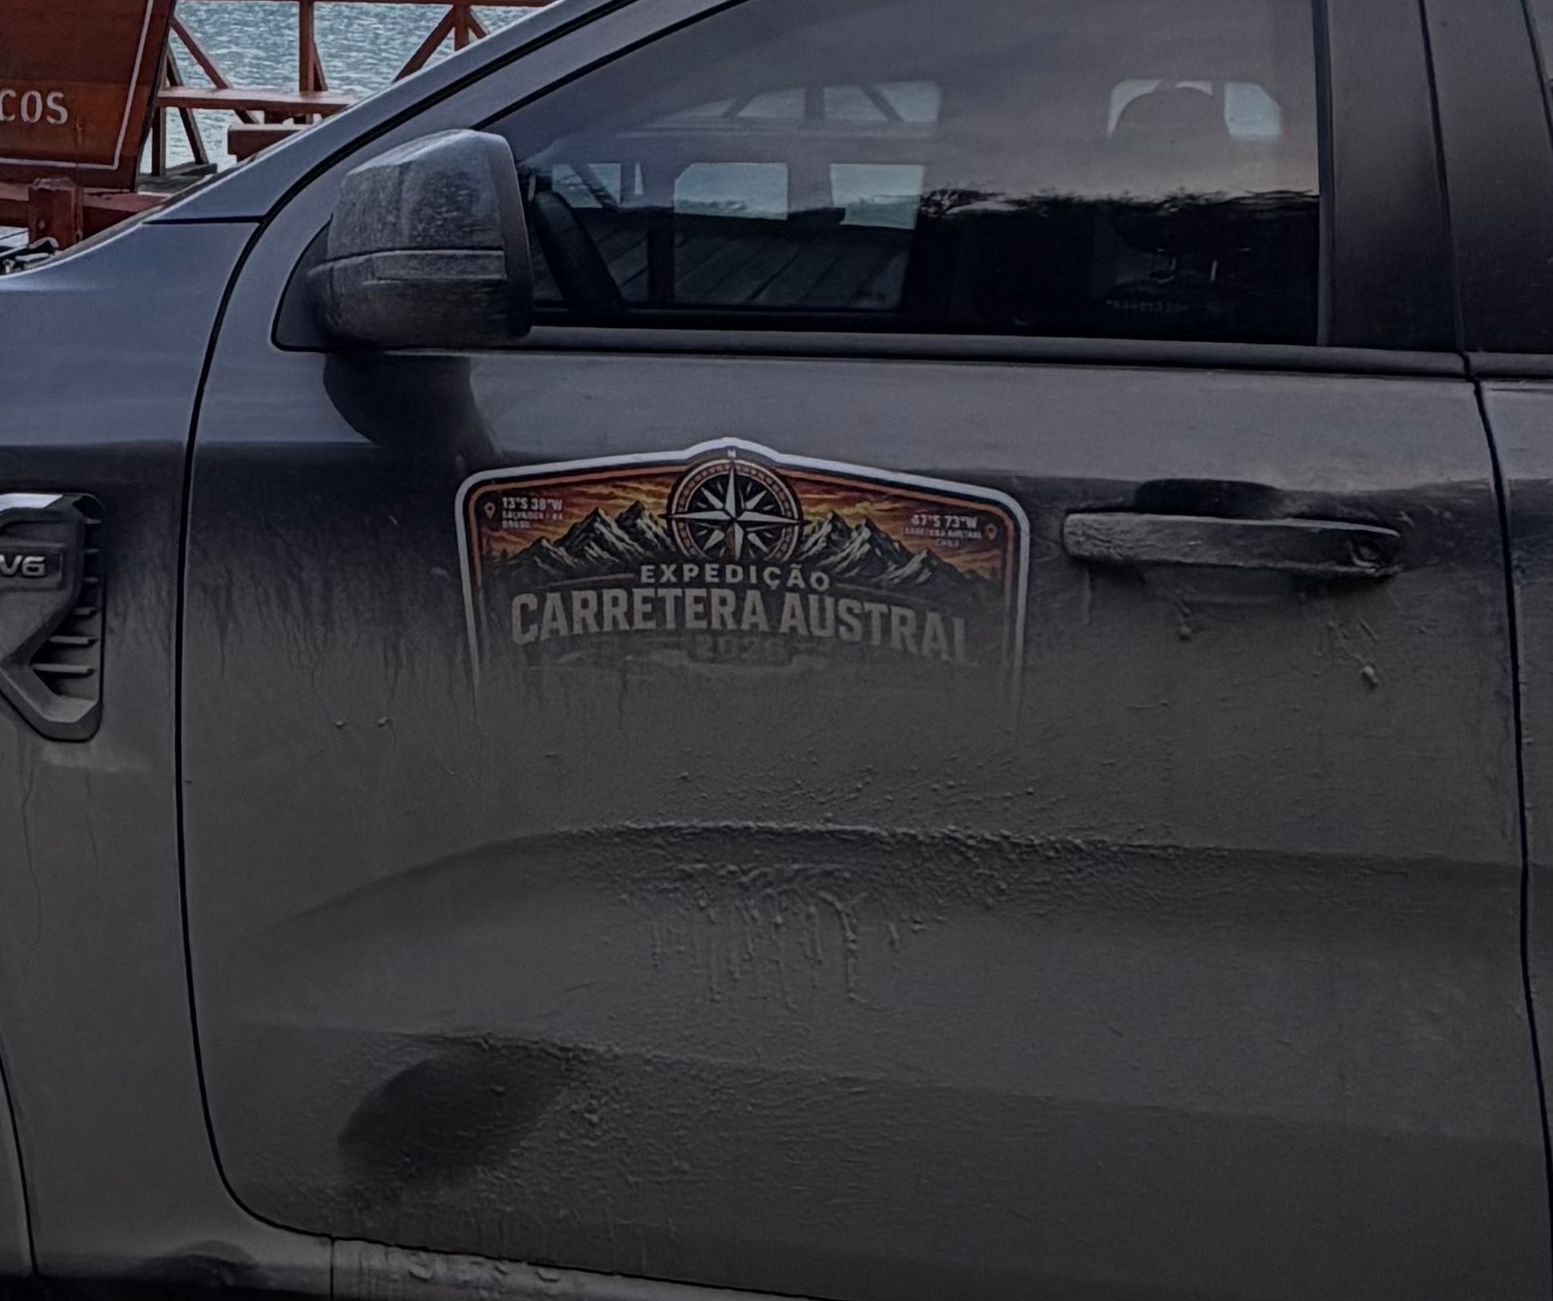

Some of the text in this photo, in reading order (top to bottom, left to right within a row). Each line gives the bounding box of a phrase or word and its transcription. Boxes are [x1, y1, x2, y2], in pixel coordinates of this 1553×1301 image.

[639, 562, 831, 592] EXPEDIÇÃO
[510, 586, 978, 666] CARRETERA AUSTRAL
